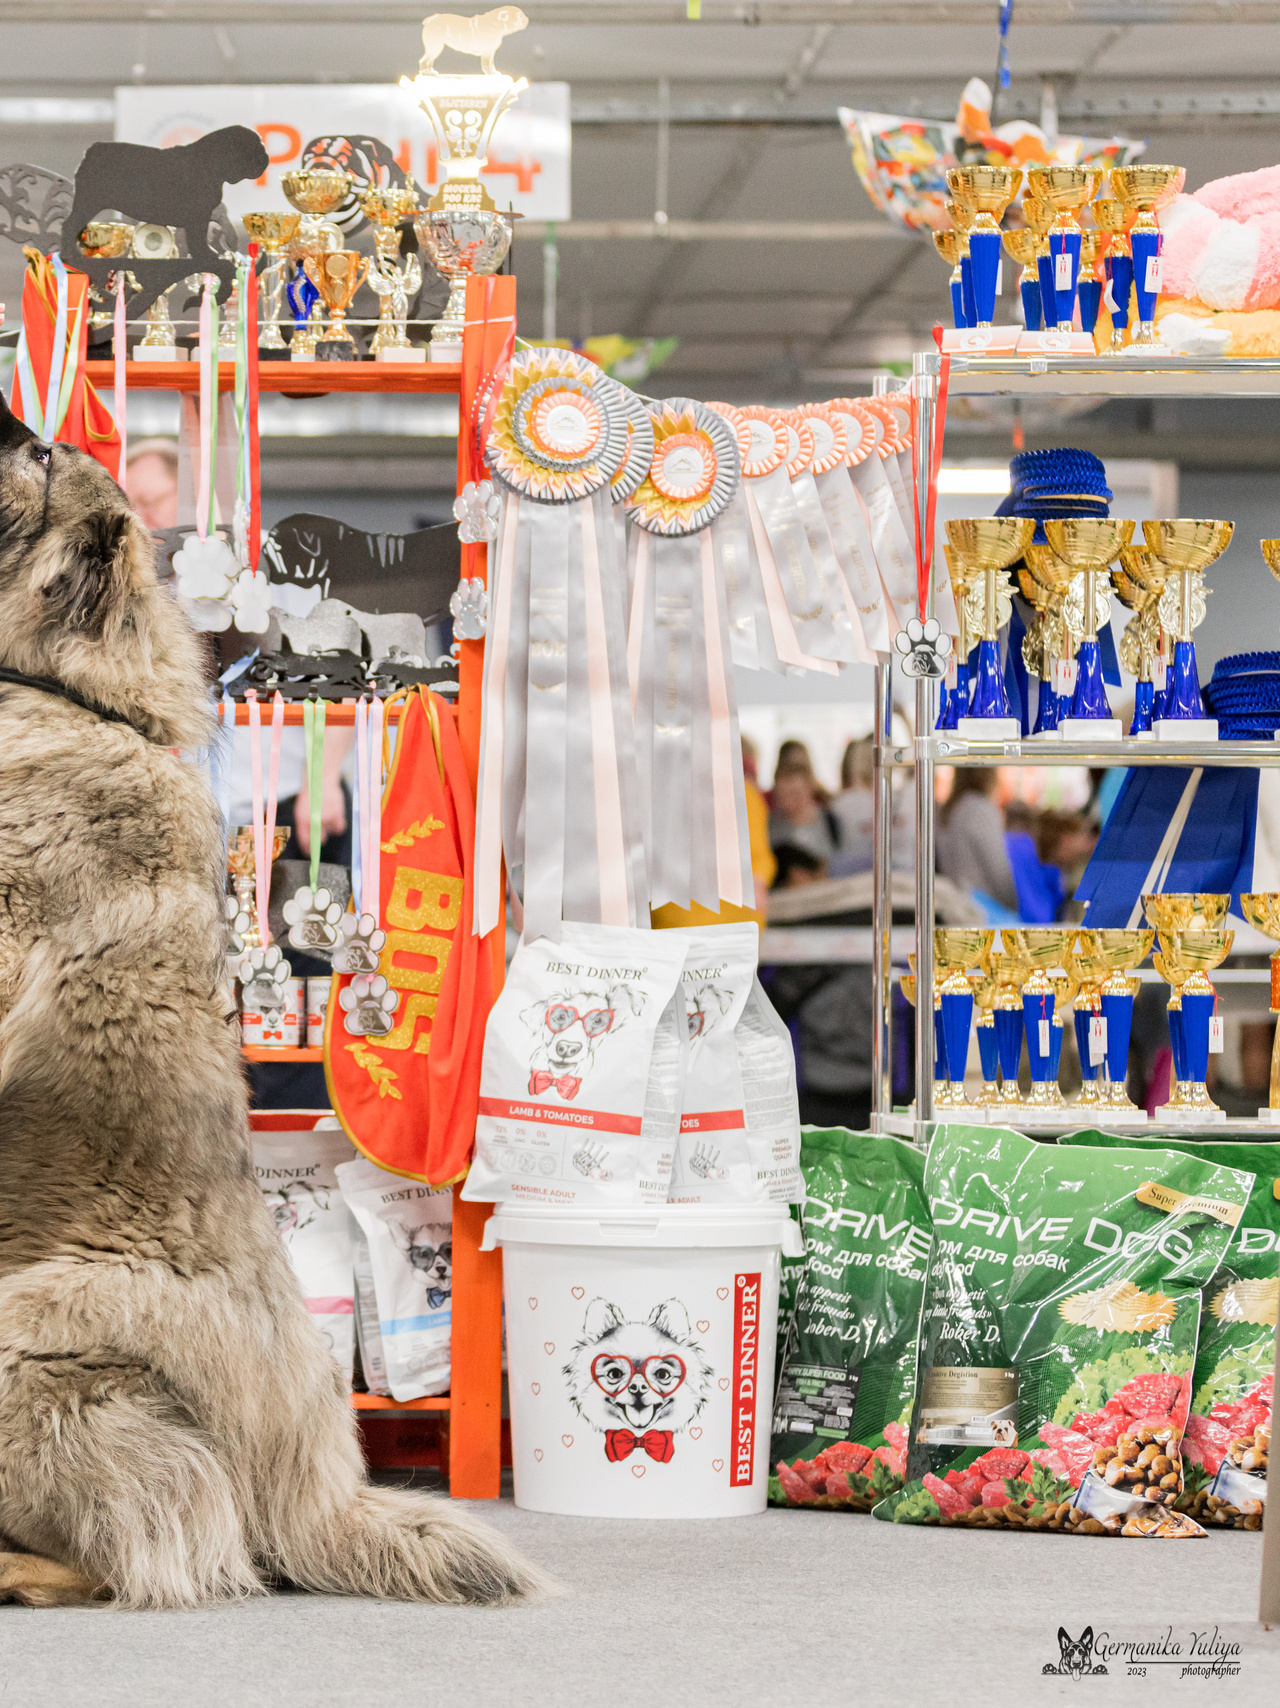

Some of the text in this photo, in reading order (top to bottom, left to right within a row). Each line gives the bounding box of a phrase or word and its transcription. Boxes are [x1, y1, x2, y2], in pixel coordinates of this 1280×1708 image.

[443, 184, 483, 194] МОСКВА
[442, 193, 483, 204] РОО КАС
[545, 961, 642, 981] BEST DINNER
[509, 1106, 594, 1124] LAMB & TOMATOES
[536, 1130, 547, 1139] 0%
[774, 1137, 789, 1145] SUPER
[771, 1145, 793, 1153] PREMIUM
[773, 1152, 793, 1162] QUALITY
[254, 1166, 316, 1179] DINNER
[757, 1168, 780, 1180] BEST
[380, 1189, 413, 1204] BEST
[511, 1184, 576, 1199] SENSIBLE ADULT
[1149, 1187, 1177, 1206] Super
[802, 1196, 933, 1260] DRIVE
[932, 1197, 1194, 1266] DRIVE DOG
[833, 1250, 873, 1267] для
[964, 1245, 1009, 1266] для
[1013, 1250, 1071, 1273] собак
[807, 1256, 845, 1280] food
[939, 1321, 1001, 1343] Rober D.
[739, 1282, 758, 1401] DINNER
[802, 1368, 823, 1378] SUPER
[823, 1370, 846, 1381] FOOD
[736, 1407, 754, 1484] BEST
